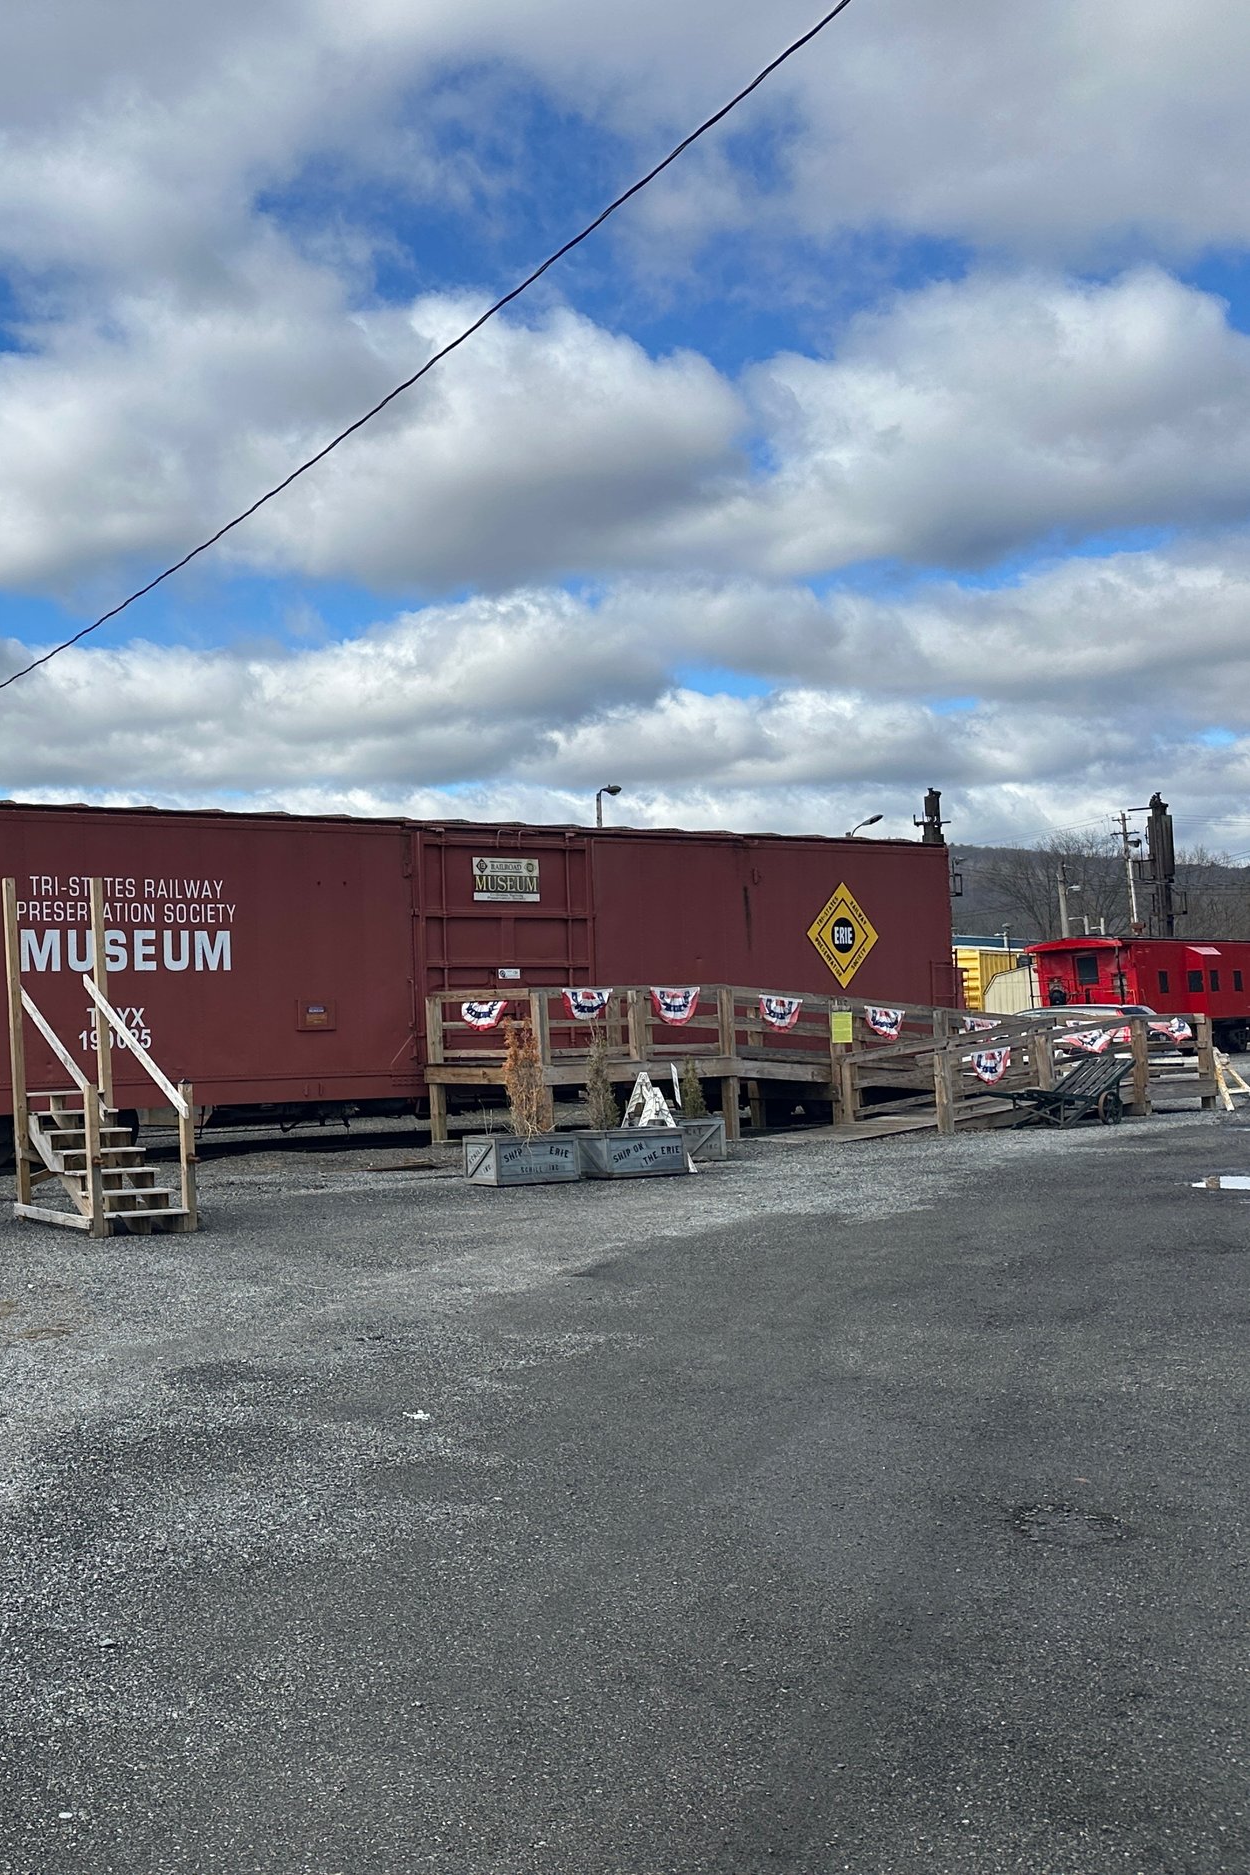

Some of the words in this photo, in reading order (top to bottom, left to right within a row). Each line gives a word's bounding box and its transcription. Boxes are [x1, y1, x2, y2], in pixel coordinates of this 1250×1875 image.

[490, 863, 522, 871] RAILROAD
[29, 875, 136, 899] TRI-STTES
[144, 878, 224, 899] RAILWAY
[475, 875, 538, 892] MUSEUM
[16, 901, 156, 923] PRESERATION
[163, 903, 237, 923] SOCIETY
[833, 926, 853, 945] ERIE
[20, 928, 232, 972] MUSEUM
[86, 1007, 146, 1028] TYX
[503, 1148, 523, 1163] SHIP
[549, 1145, 570, 1159] ERIE
[612, 1148, 631, 1163] SHIP
[632, 1141, 645, 1154] ON
[642, 1150, 659, 1166] THE
[660, 1145, 681, 1155] ERIE
